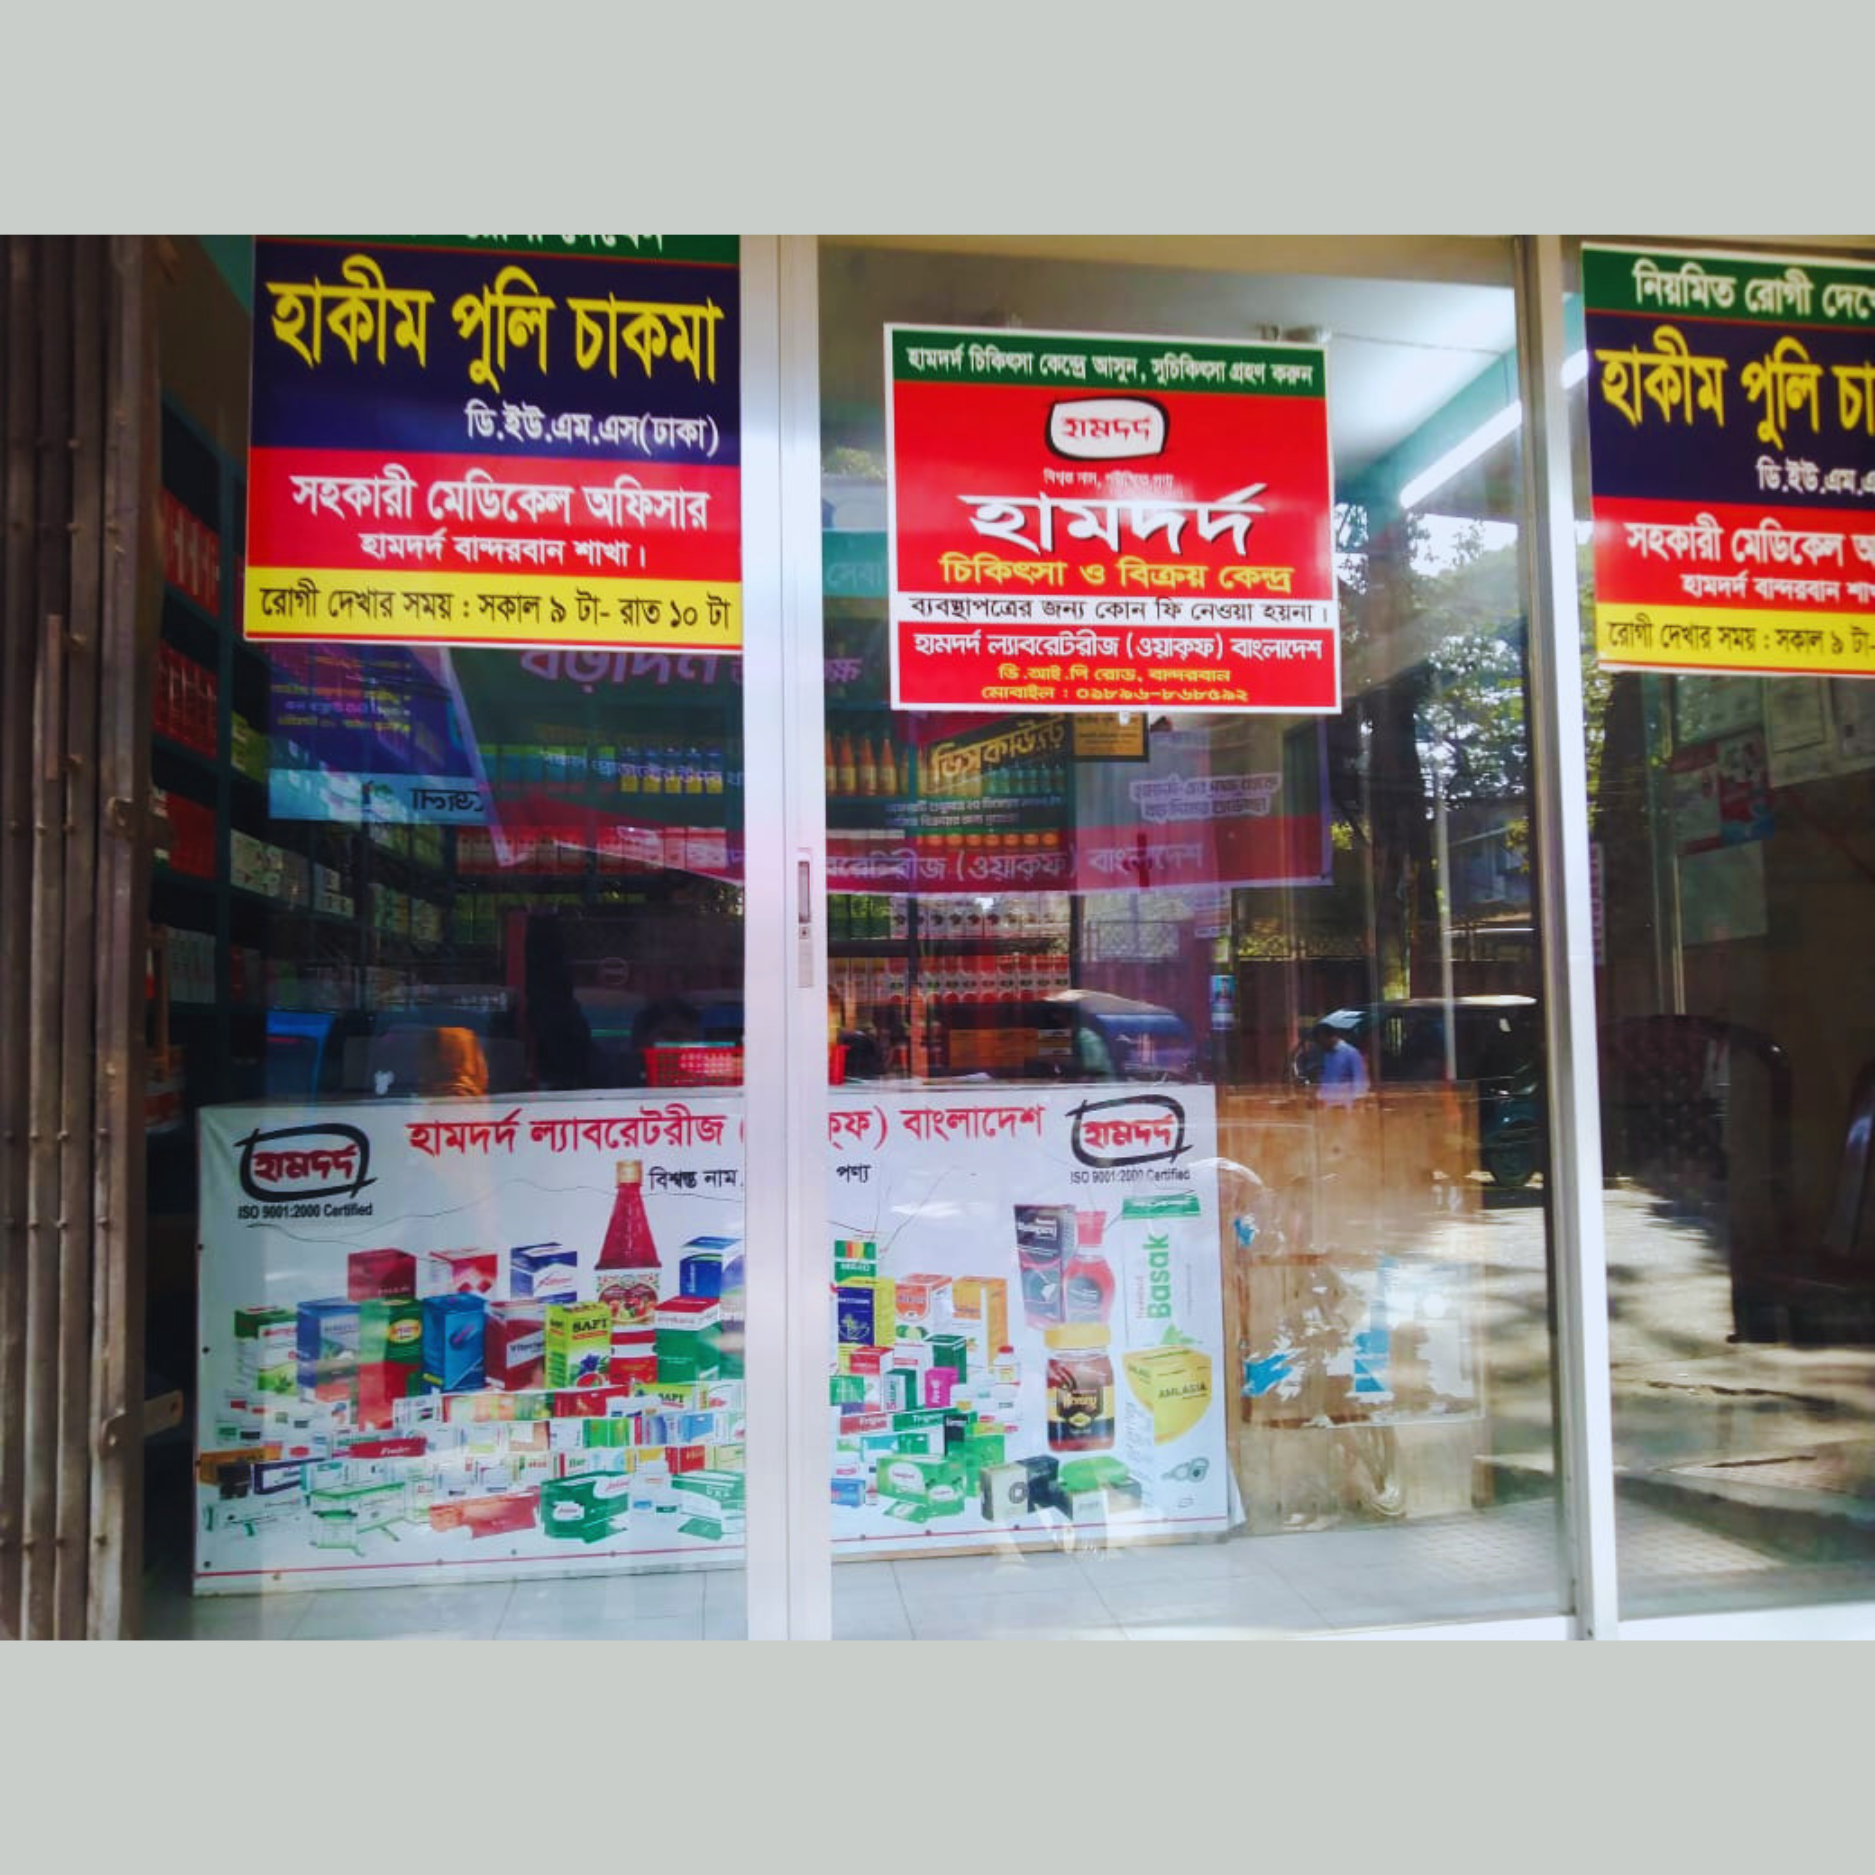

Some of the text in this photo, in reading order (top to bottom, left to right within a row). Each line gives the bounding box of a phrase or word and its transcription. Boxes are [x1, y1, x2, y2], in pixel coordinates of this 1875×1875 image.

[1632, 258, 1736, 310] নিয়মিত
[1745, 267, 1814, 315] রোগী
[265, 253, 724, 393] হাকীম পুলি চাকমা
[906, 343, 964, 373] হামদর্দ
[969, 344, 1034, 374] চিকিৎসা
[1594, 324, 1728, 429] হাকীম
[1741, 335, 1822, 451] পুলি
[289, 462, 710, 531] সহকারী মেডিকেল অফিসার
[957, 481, 1270, 557] হামদর্দ
[1624, 513, 1724, 563] সহকারী
[1731, 517, 1846, 569] মেডিকেল
[358, 527, 448, 561] হামদর্দ
[453, 537, 564, 564] বান্দরবান
[939, 551, 1295, 595] চিকিৎসা ও বিক্রয় কেন্দ্র
[1681, 569, 1750, 600] হামদর্দ
[1754, 577, 1841, 603] বান্দরবান
[259, 578, 320, 618] রোগী
[328, 587, 394, 621] দেখার
[403, 591, 453, 622] সময়
[478, 592, 540, 623] সকাল
[619, 597, 660, 628] রাত
[707, 593, 731, 632] টা
[1041, 600, 1085, 621] জন্য
[1094, 600, 1147, 622] কোন
[1154, 596, 1182, 621] ফি
[1190, 602, 1254, 623] নেওয়া
[913, 630, 982, 655] হামদর্দ
[987, 628, 1120, 660] ল্যাবরেটরীজ
[1230, 638, 1323, 661] বাংলাদেশ
[1608, 612, 1653, 649] রোগী
[1660, 620, 1711, 651] দেখার
[1717, 626, 1757, 654] সময়
[1775, 628, 1825, 656] সকাল
[405, 1108, 523, 1158] হামদর্দ
[530, 1103, 728, 1153] ল্যাবরেটরীজ
[899, 1105, 1047, 1144] বাংলাদেশ
[1081, 1113, 1174, 1148] হামদর্দ
[253, 1142, 358, 1183] হামদর্দ
[1070, 1171, 1090, 1185] ISO
[237, 1205, 260, 1219] ISO
[323, 1202, 374, 1217] Certified
[1141, 1233, 1172, 1319] Basak
[571, 1317, 608, 1333] SAFI
